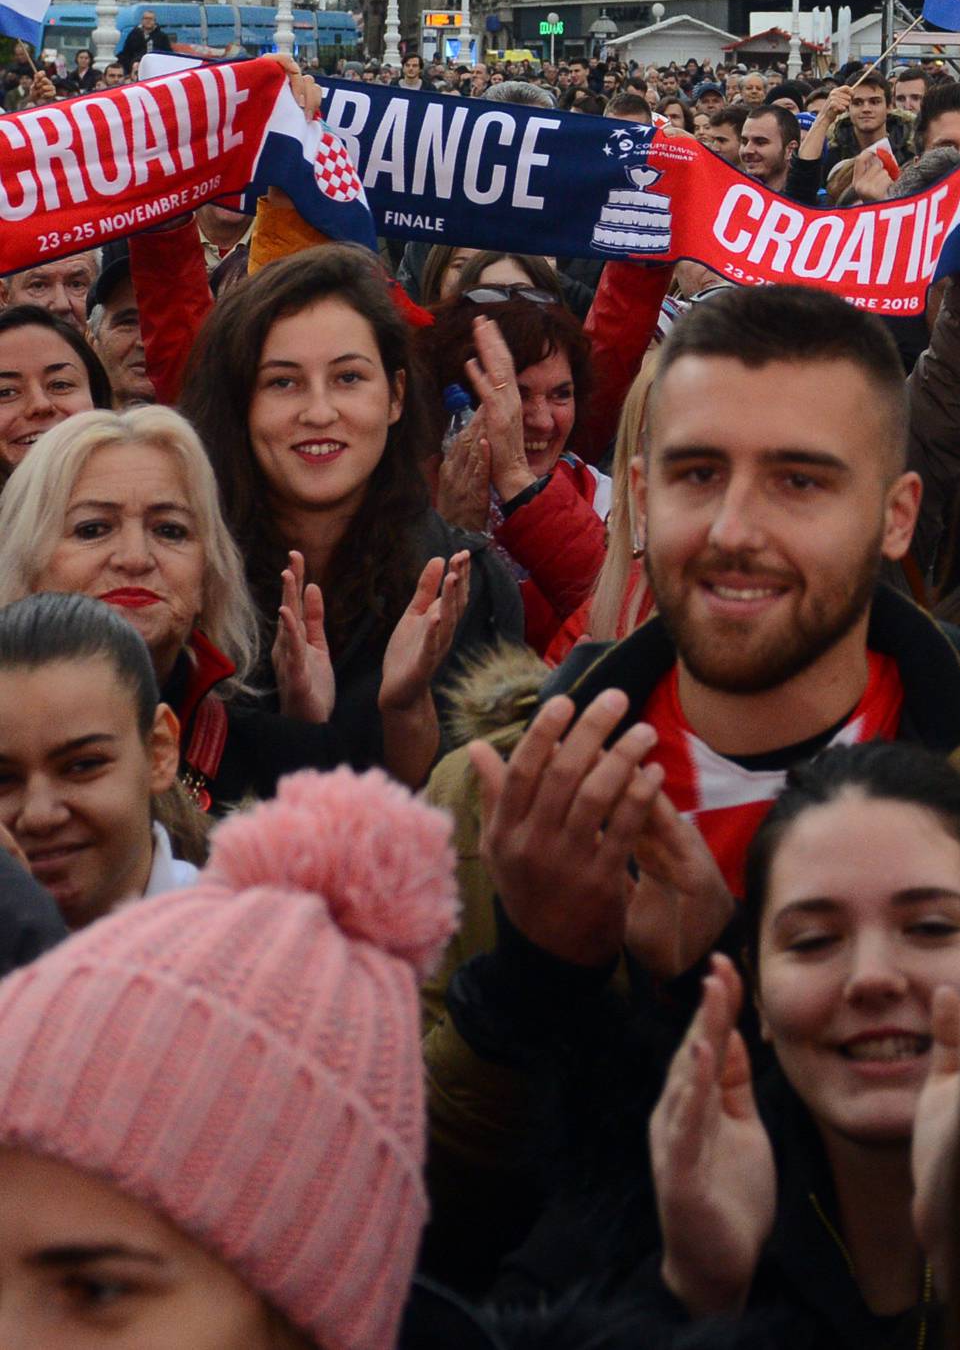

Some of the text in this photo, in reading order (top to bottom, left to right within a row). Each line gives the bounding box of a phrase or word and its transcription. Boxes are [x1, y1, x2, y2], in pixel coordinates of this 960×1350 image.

[0, 65, 249, 222] CROATIE
[321, 86, 561, 210] RANCE
[99, 190, 189, 234] NOVEMBRE
[191, 175, 222, 201] 2018
[384, 210, 445, 231] FINALE
[713, 183, 948, 285] CROATIE
[882, 297, 919, 310] 2018
